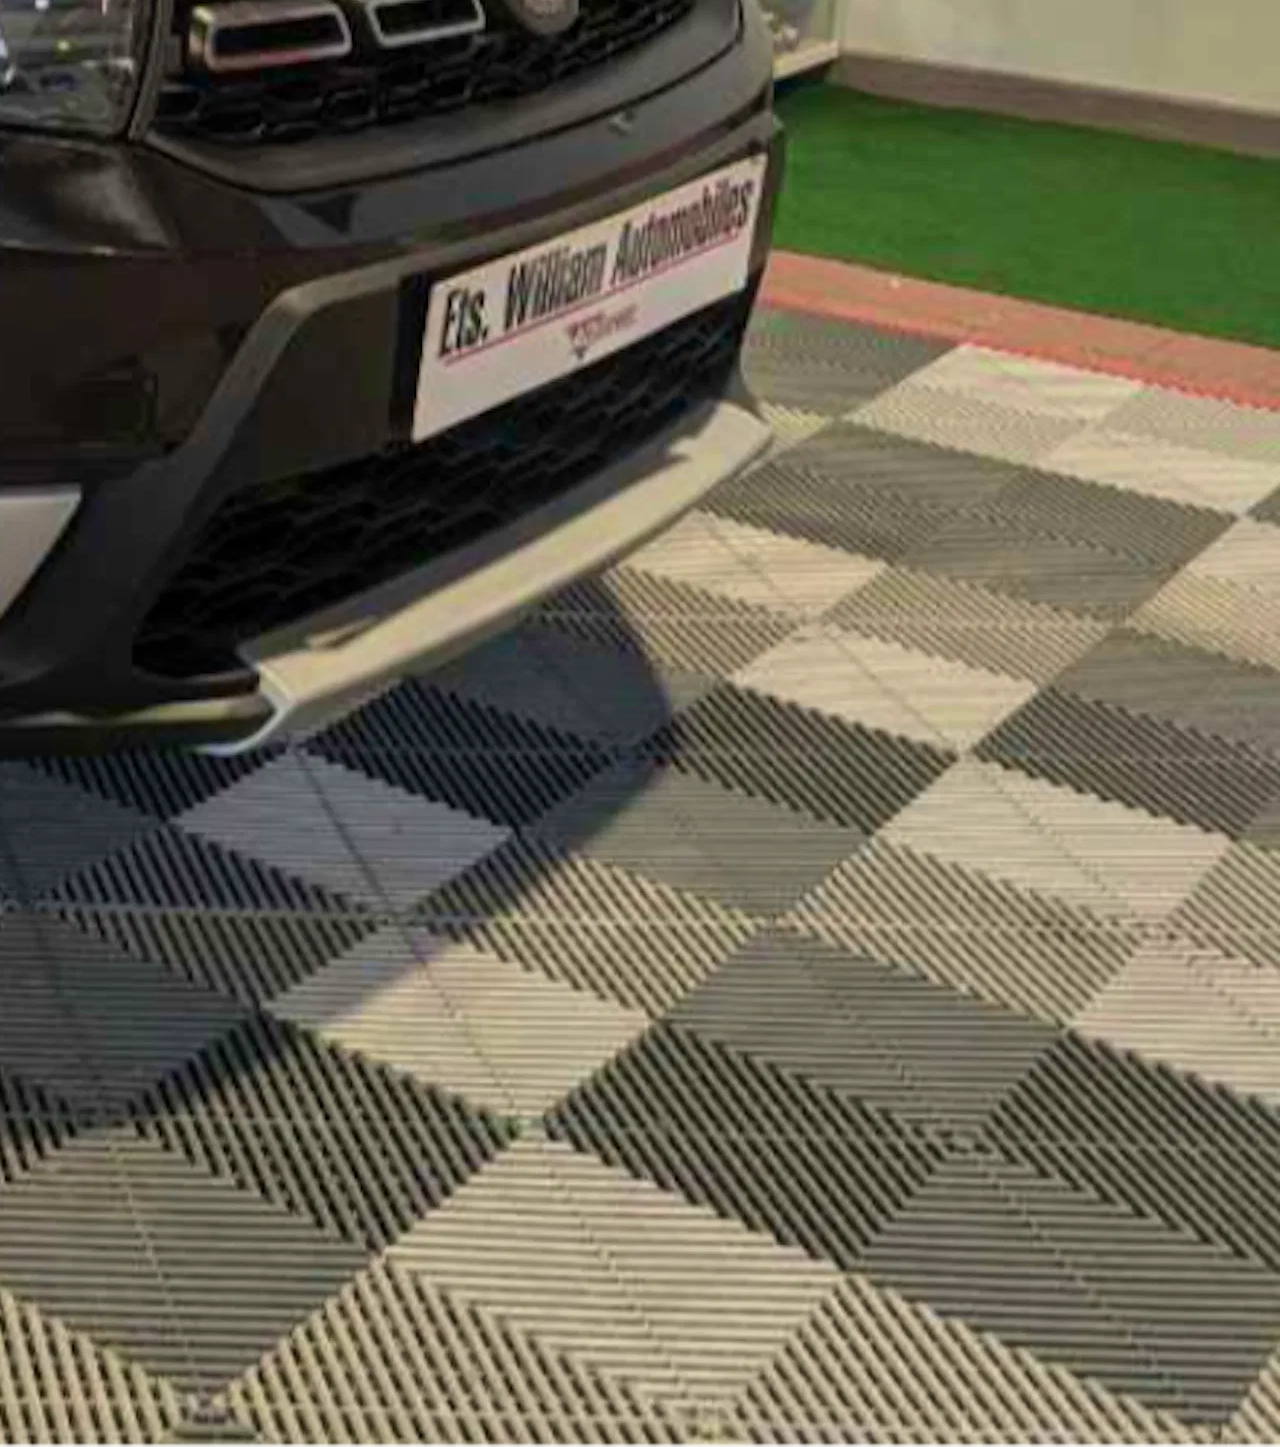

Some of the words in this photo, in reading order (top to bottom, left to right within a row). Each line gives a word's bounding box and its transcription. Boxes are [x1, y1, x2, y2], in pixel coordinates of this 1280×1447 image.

[439, 287, 490, 358] Ets.
[503, 242, 608, 332] William
[611, 179, 753, 286] Automobiles
